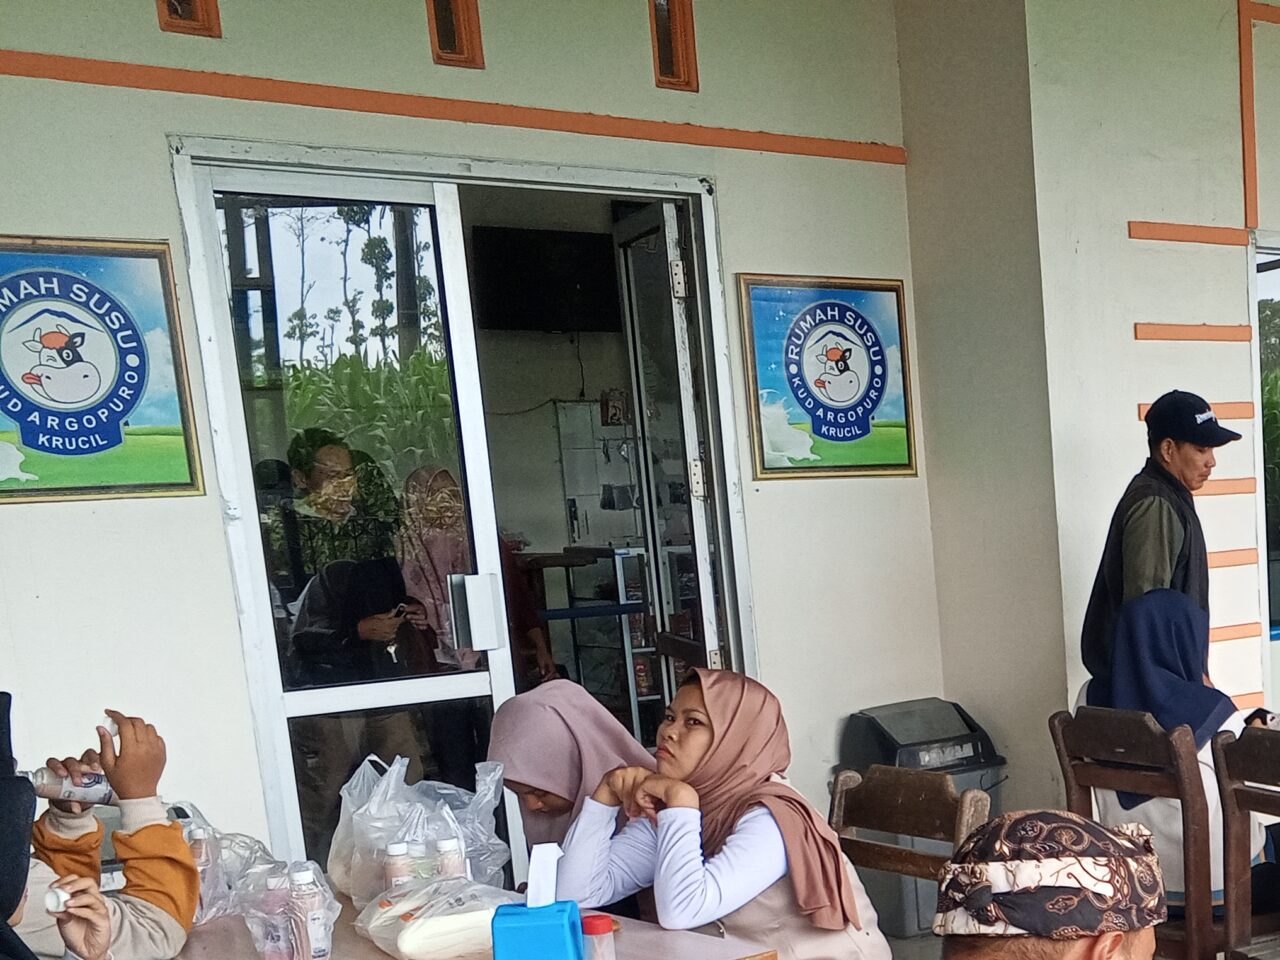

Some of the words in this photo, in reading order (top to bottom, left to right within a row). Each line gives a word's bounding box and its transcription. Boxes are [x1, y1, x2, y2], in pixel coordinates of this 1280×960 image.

[69, 283, 138, 349] SUSU
[788, 306, 839, 360] RUMAH
[844, 311, 882, 361] SUSU
[27, 370, 139, 431] ARGOPURO
[791, 377, 814, 409] KUD
[816, 379, 882, 423] ARGOPURO
[38, 433, 108, 449] KRUCIL
[821, 425, 862, 437] KRUCIL
